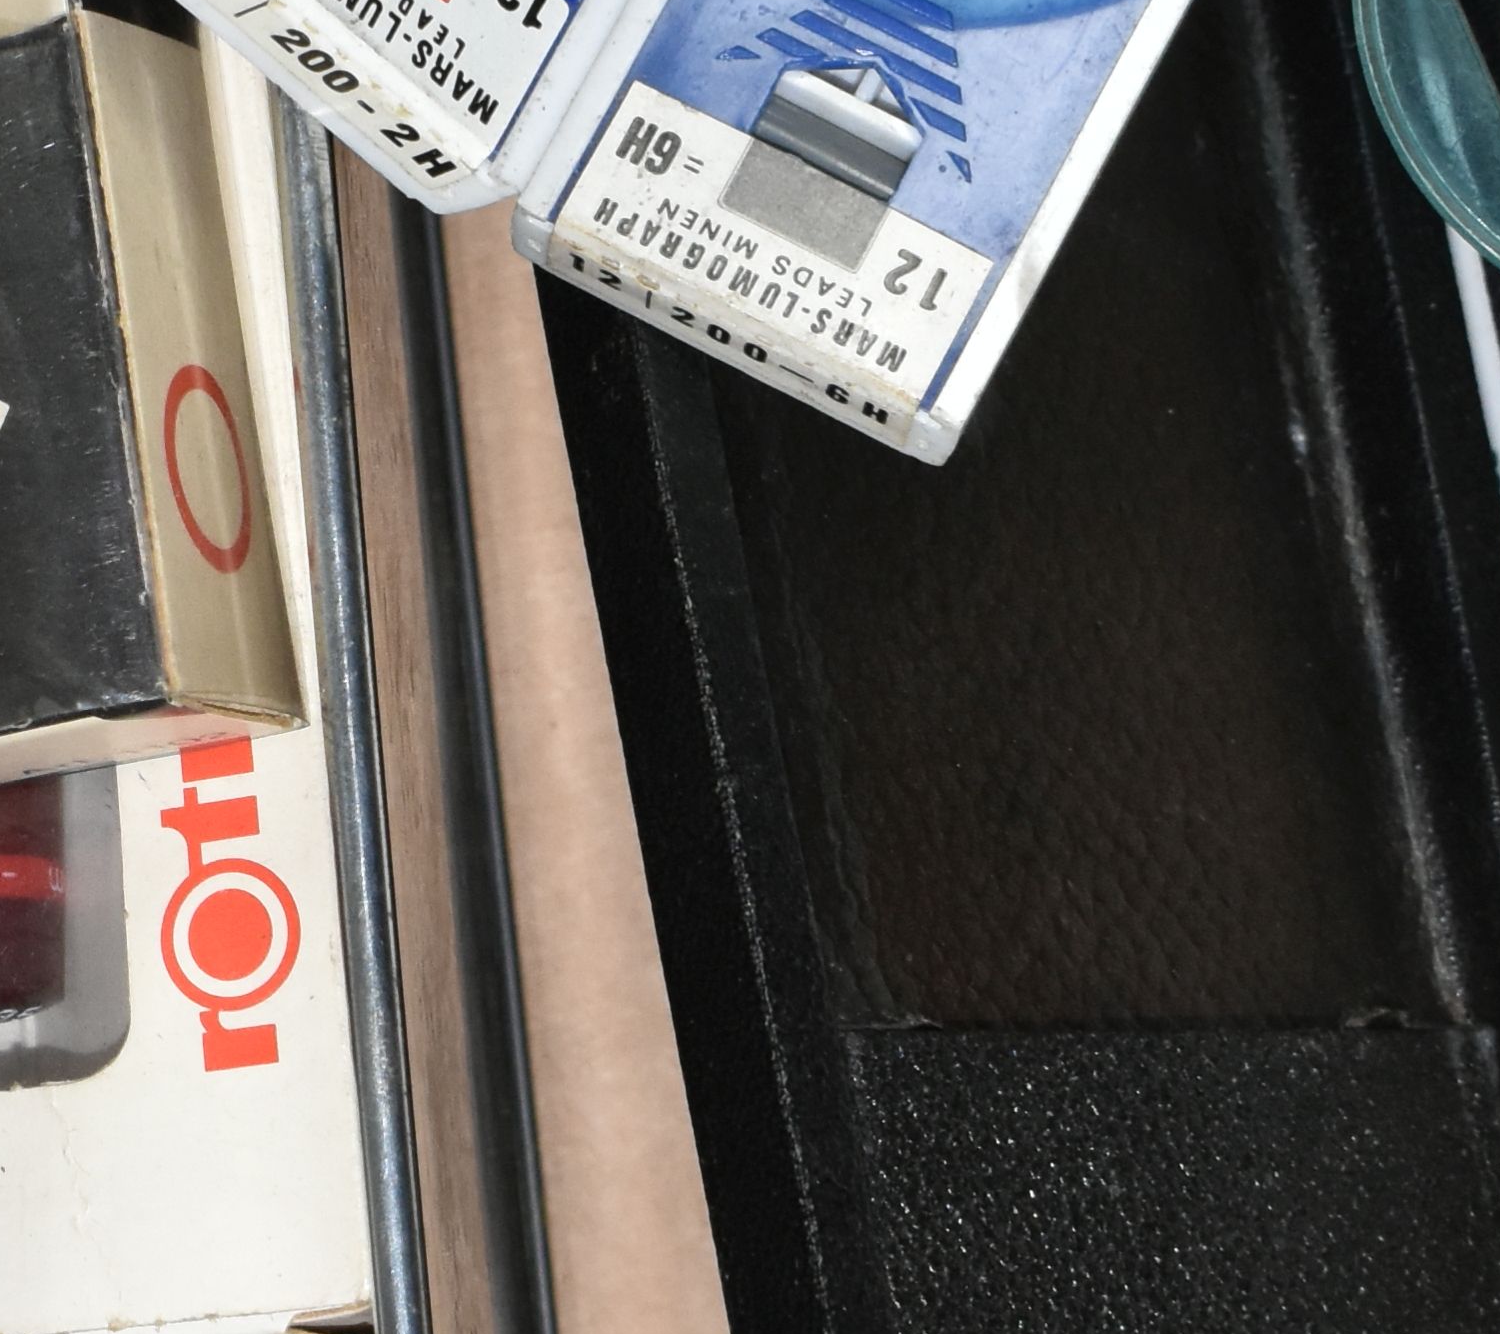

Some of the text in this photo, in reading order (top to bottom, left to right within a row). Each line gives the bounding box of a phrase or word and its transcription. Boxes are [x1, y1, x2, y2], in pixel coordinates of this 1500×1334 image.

[592, 195, 908, 374] MARS-LUMOGRAPH
[655, 196, 874, 318] LEADS MINEN
[881, 246, 949, 312] 12
